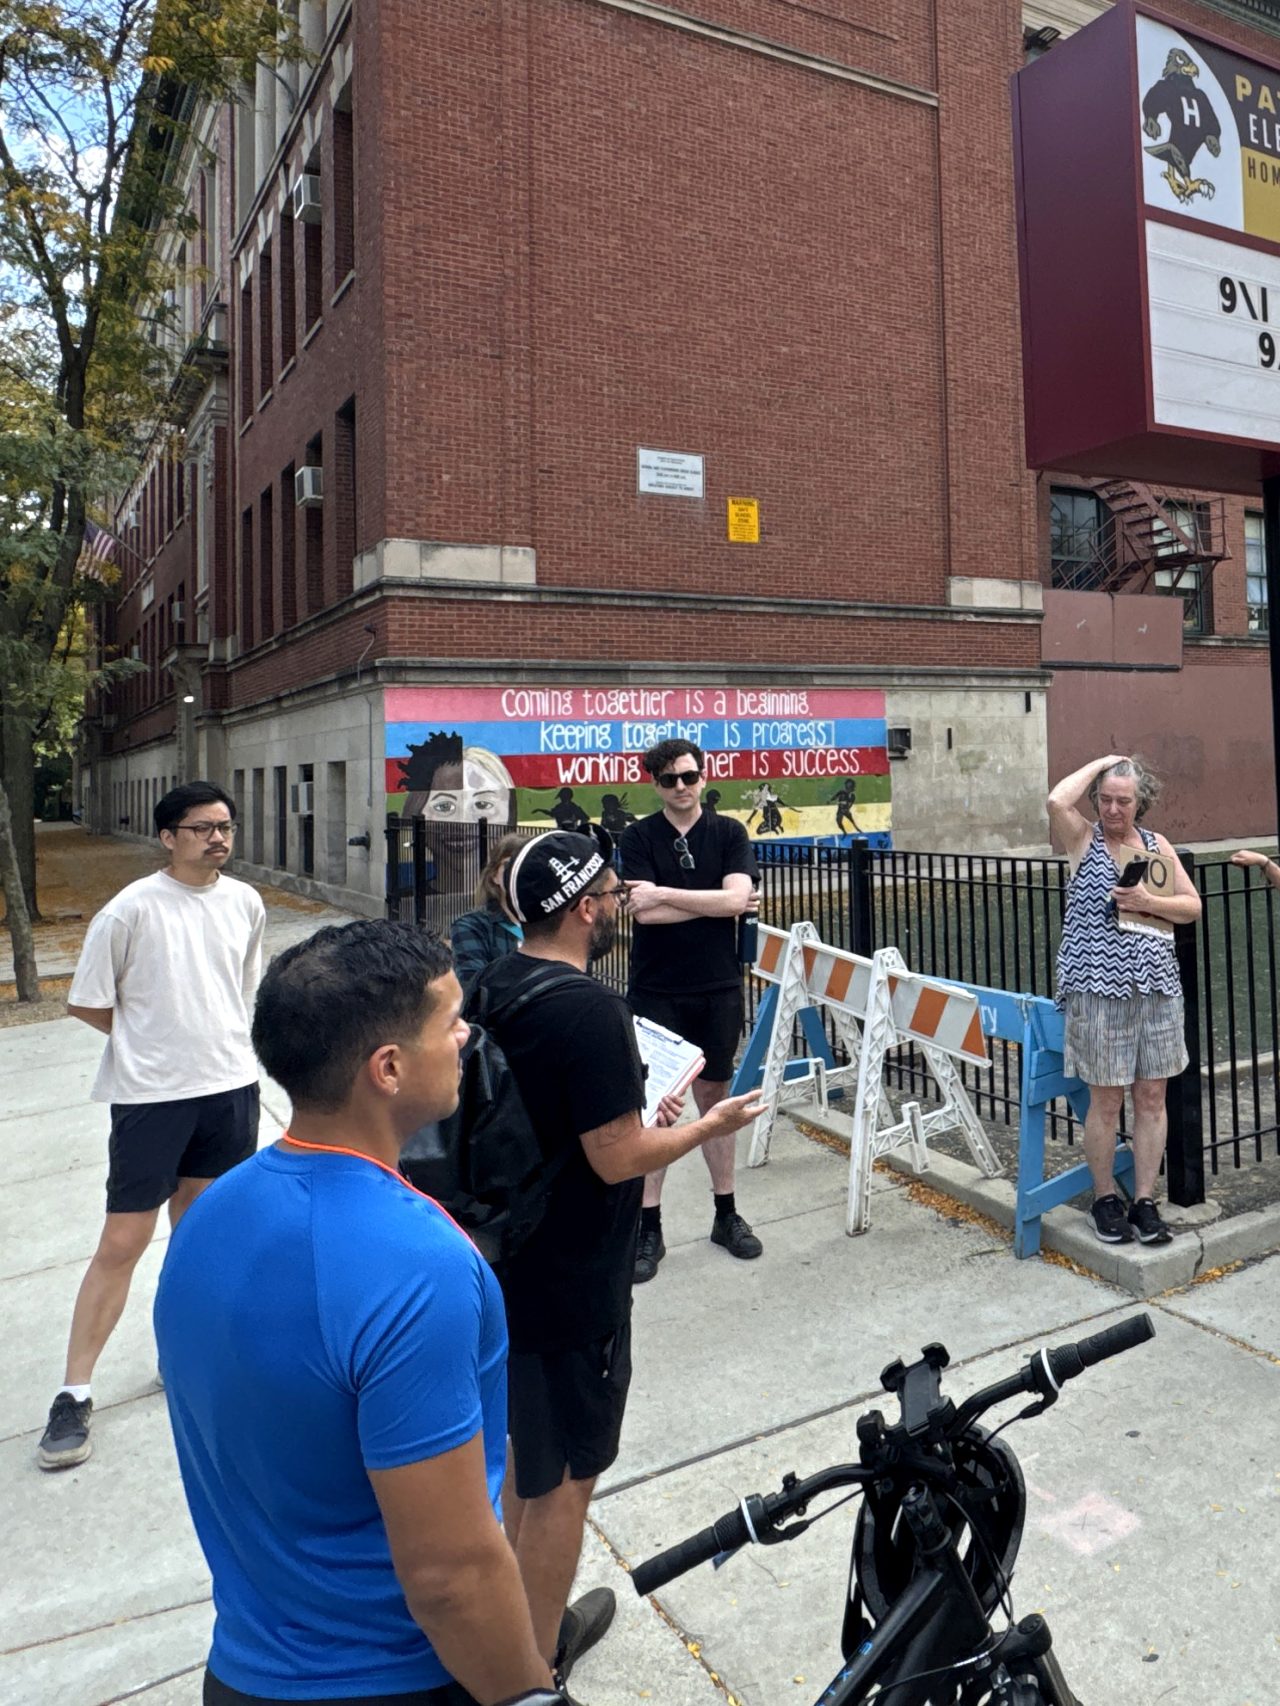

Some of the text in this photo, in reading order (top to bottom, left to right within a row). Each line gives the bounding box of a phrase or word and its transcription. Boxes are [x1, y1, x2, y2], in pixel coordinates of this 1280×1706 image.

[1182, 96, 1200, 128] H
[582, 689, 675, 716] together
[686, 690, 704, 715] is
[714, 691, 726, 715] a
[752, 750, 769, 776] is
[540, 852, 605, 913] SAN FRANCISCO
